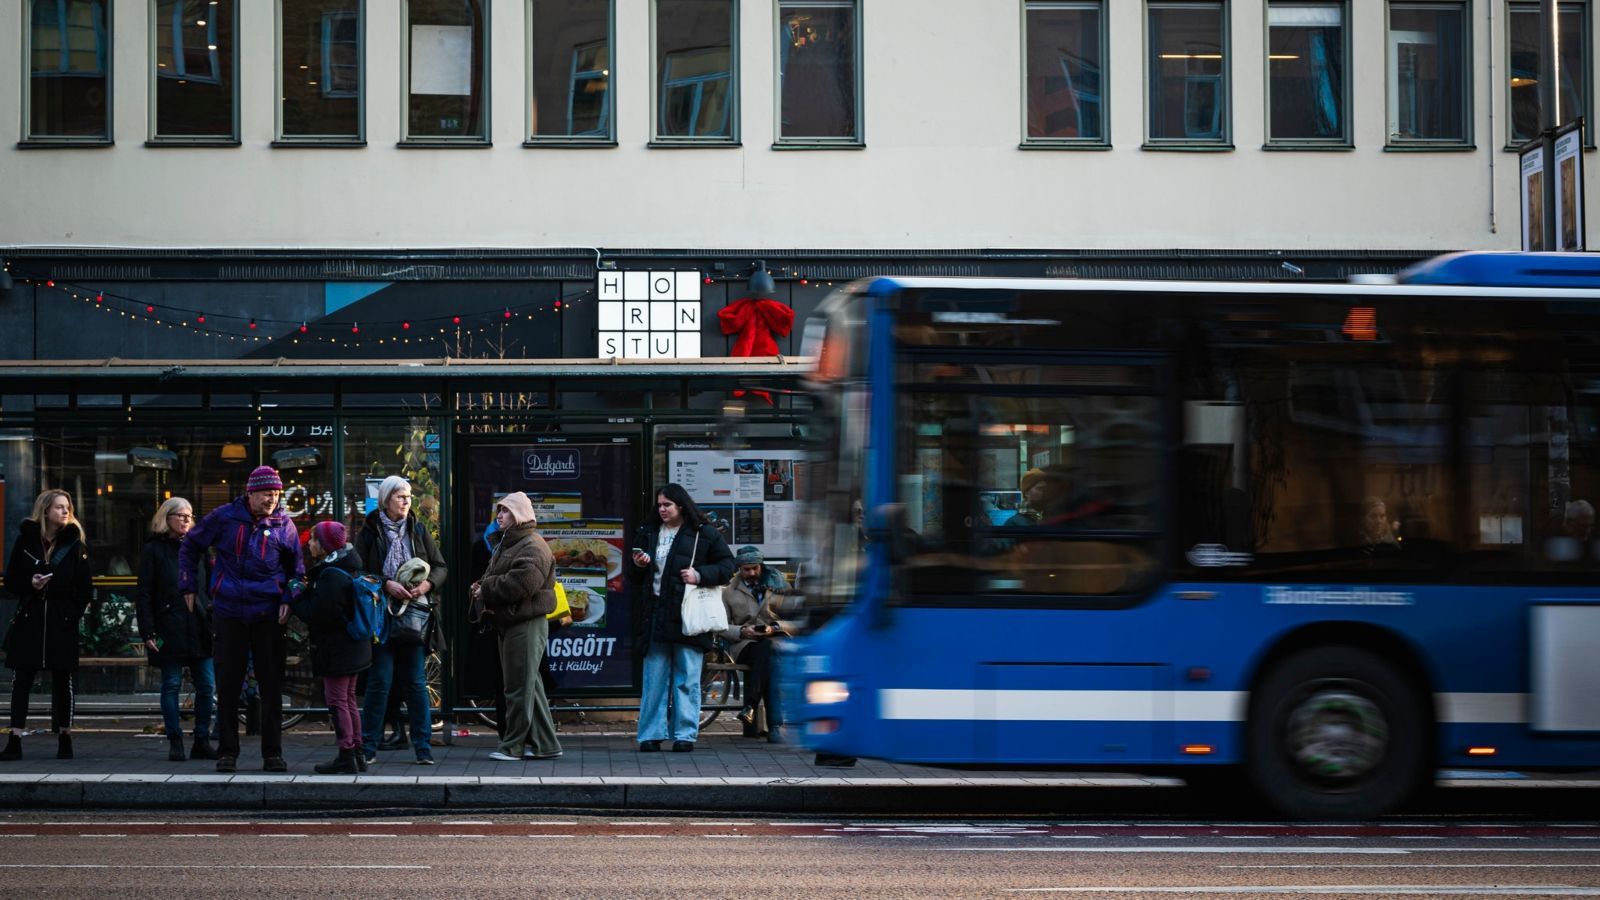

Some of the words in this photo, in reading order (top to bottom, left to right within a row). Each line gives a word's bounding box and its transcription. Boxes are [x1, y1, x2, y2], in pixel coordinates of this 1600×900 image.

[310, 425, 349, 436] BA
[527, 454, 576, 477] Dafgårds
[566, 660, 604, 674] Källby!
